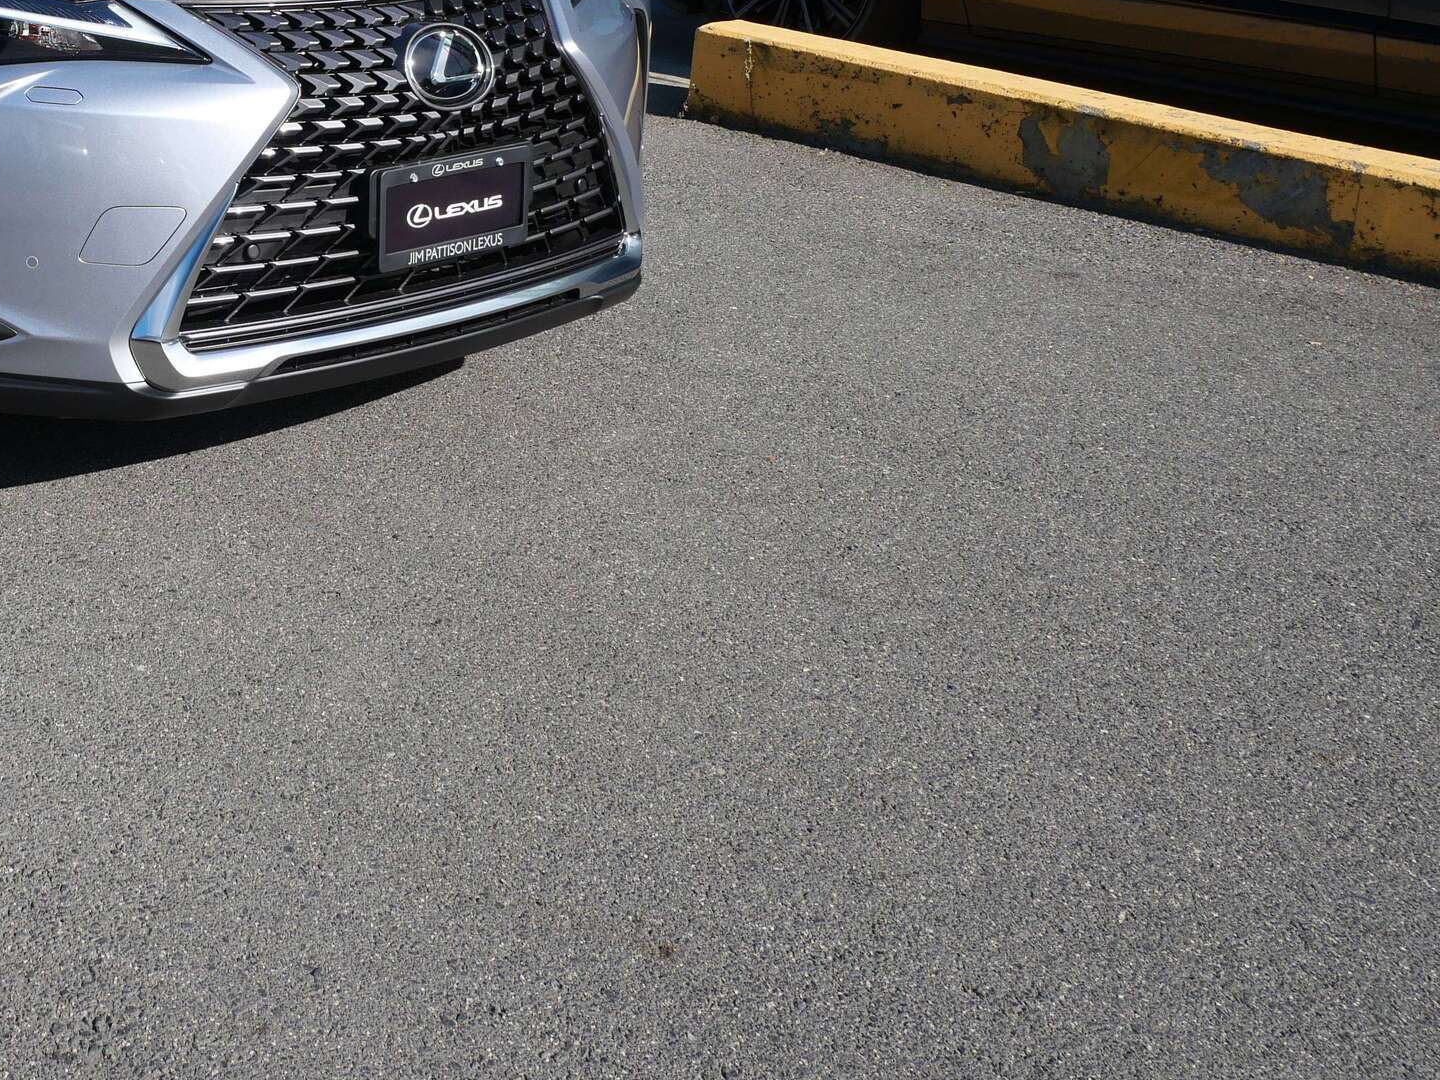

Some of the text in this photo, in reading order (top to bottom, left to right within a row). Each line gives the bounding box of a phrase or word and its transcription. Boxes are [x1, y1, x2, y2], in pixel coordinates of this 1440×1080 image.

[445, 157, 484, 172] LEXUS
[433, 194, 503, 220] LEXUS
[408, 232, 503, 266] JIM PATTISON LEXUS
